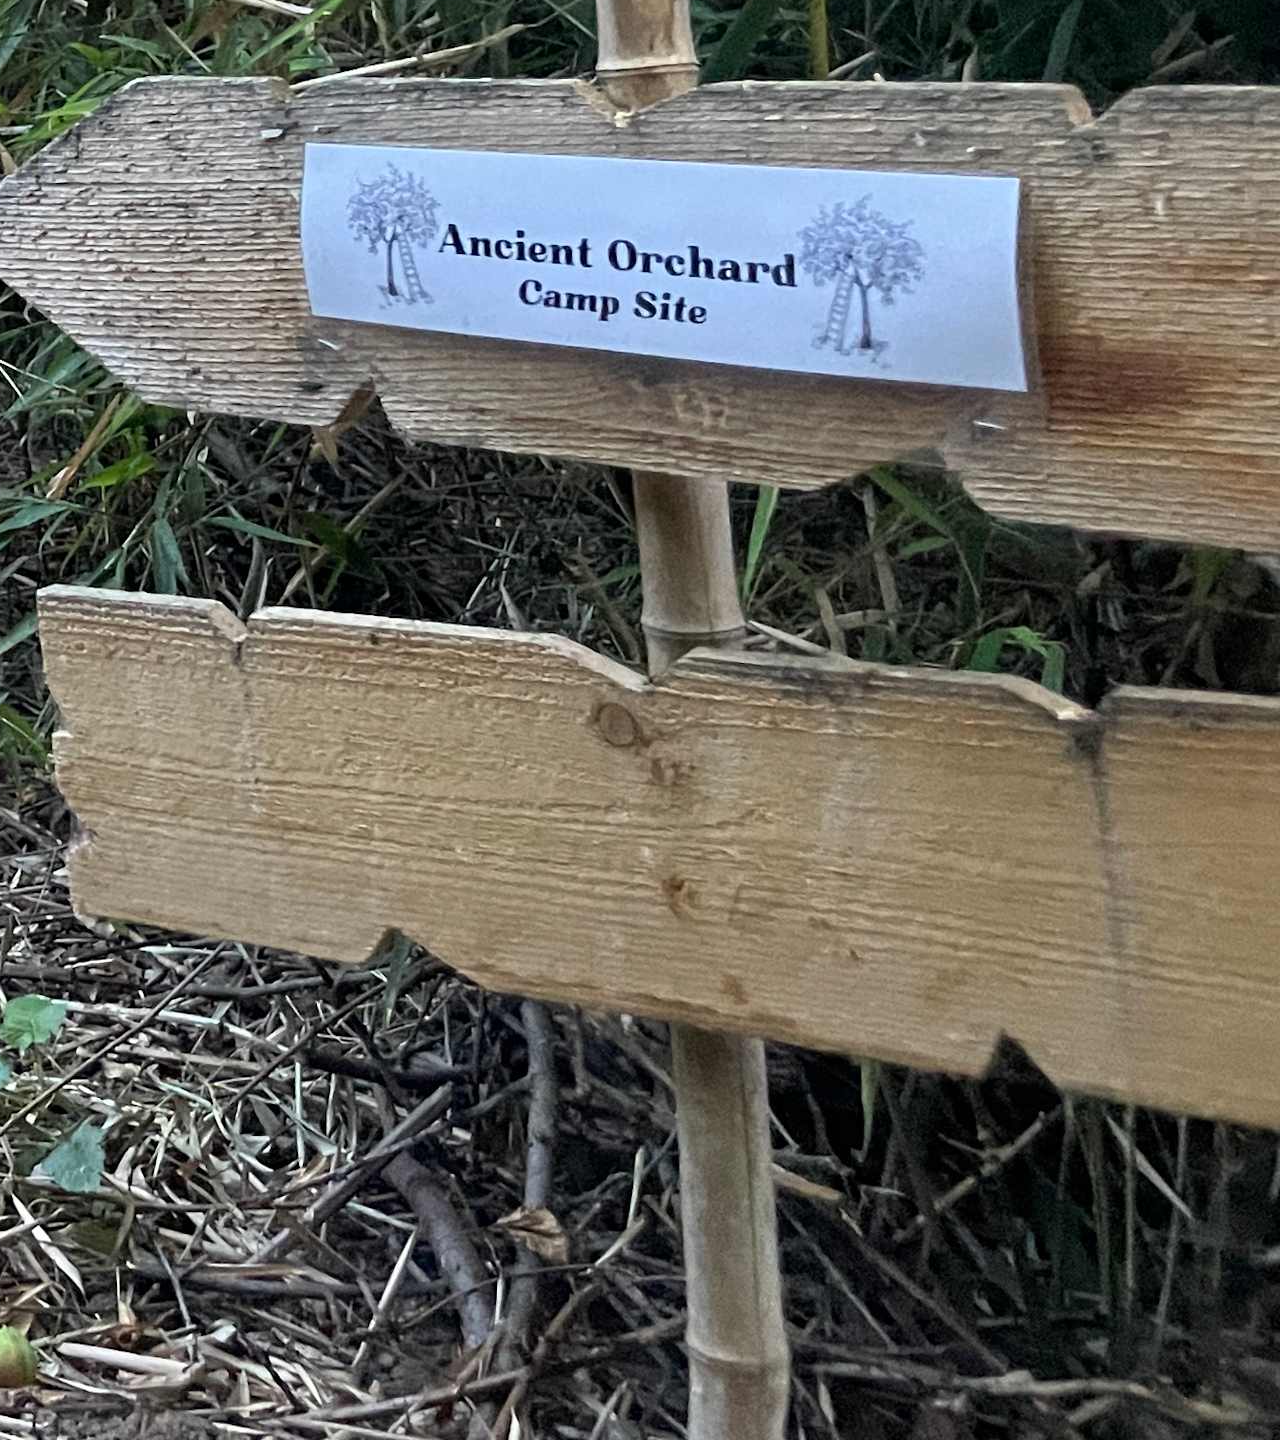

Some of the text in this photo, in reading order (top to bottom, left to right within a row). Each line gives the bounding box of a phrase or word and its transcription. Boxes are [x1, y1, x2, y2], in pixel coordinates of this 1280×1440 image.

[438, 223, 799, 288] Ancient Orchard
[518, 279, 708, 325] Camp Site
